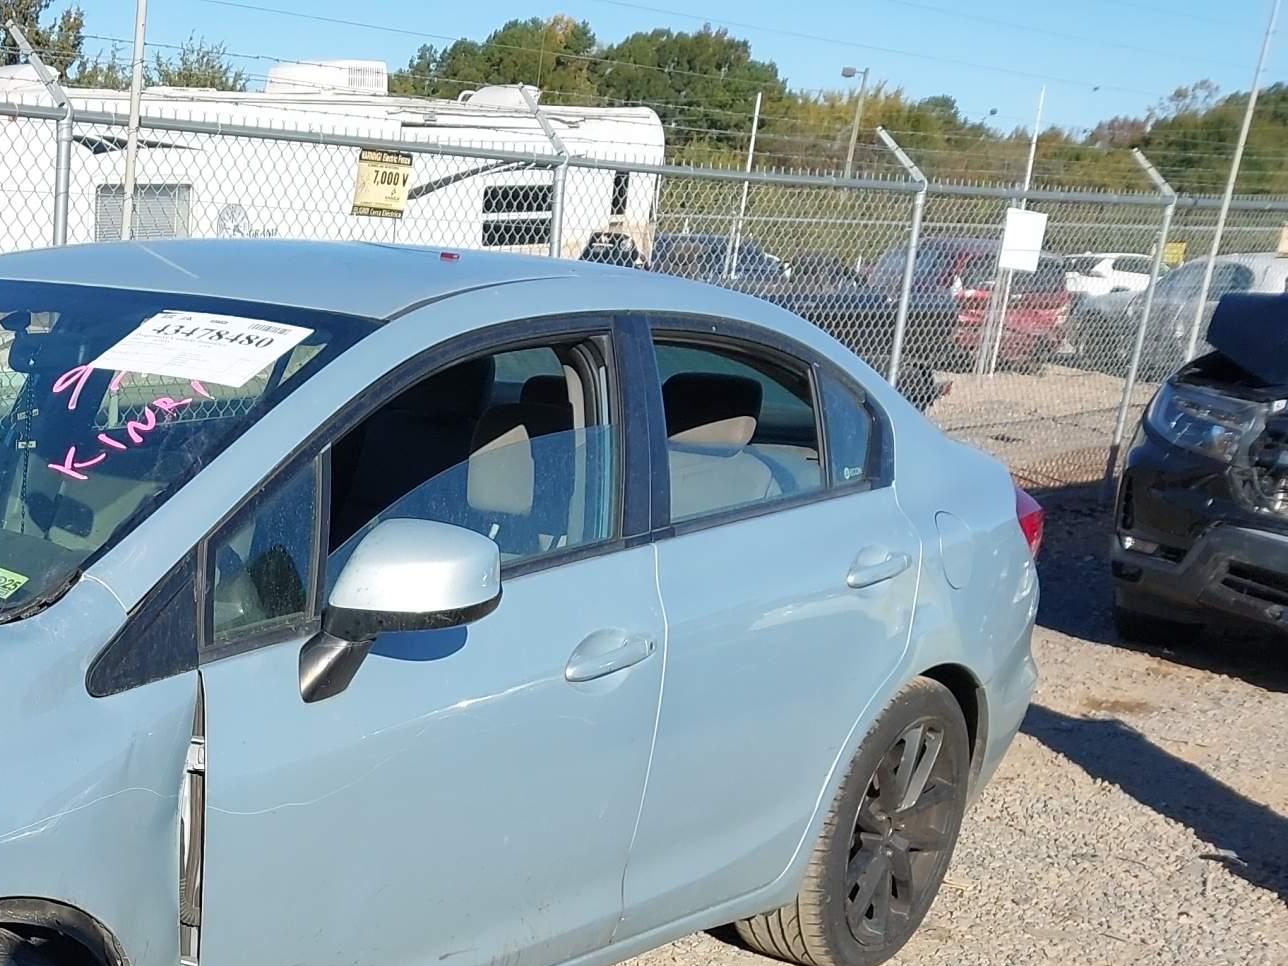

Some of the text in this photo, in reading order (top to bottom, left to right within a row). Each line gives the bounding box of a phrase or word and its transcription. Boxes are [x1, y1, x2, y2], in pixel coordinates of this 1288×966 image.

[373, 169, 409, 188] 7,000 V
[152, 323, 274, 349] 43478480
[2, 579, 21, 591] 25
